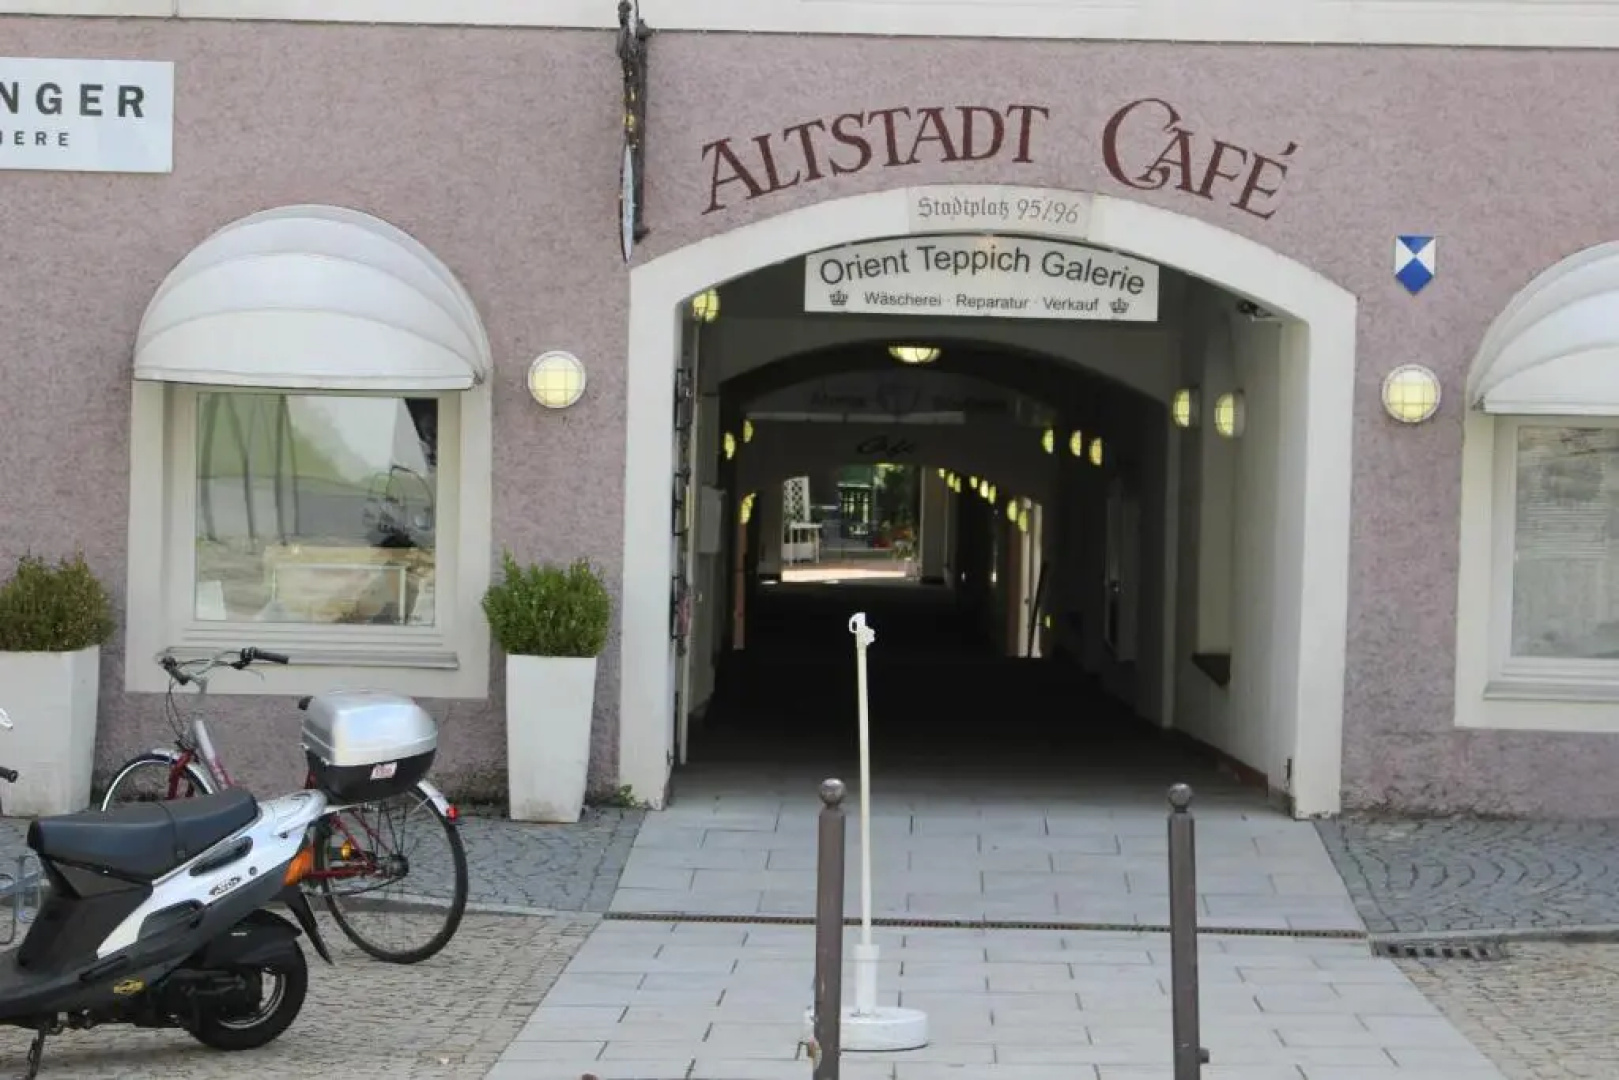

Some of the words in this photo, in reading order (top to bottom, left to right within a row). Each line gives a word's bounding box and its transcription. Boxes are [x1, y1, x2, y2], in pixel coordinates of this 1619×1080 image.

[0, 82, 145, 118] NGER
[701, 104, 1049, 216] ALTSTADT
[820, 247, 910, 285] Orient
[916, 244, 1031, 276] Teppich
[1041, 250, 1145, 295] Galerie
[864, 291, 942, 306] Wäscherei
[956, 293, 1029, 310] Reparatur
[1043, 297, 1100, 312] Verkauf
